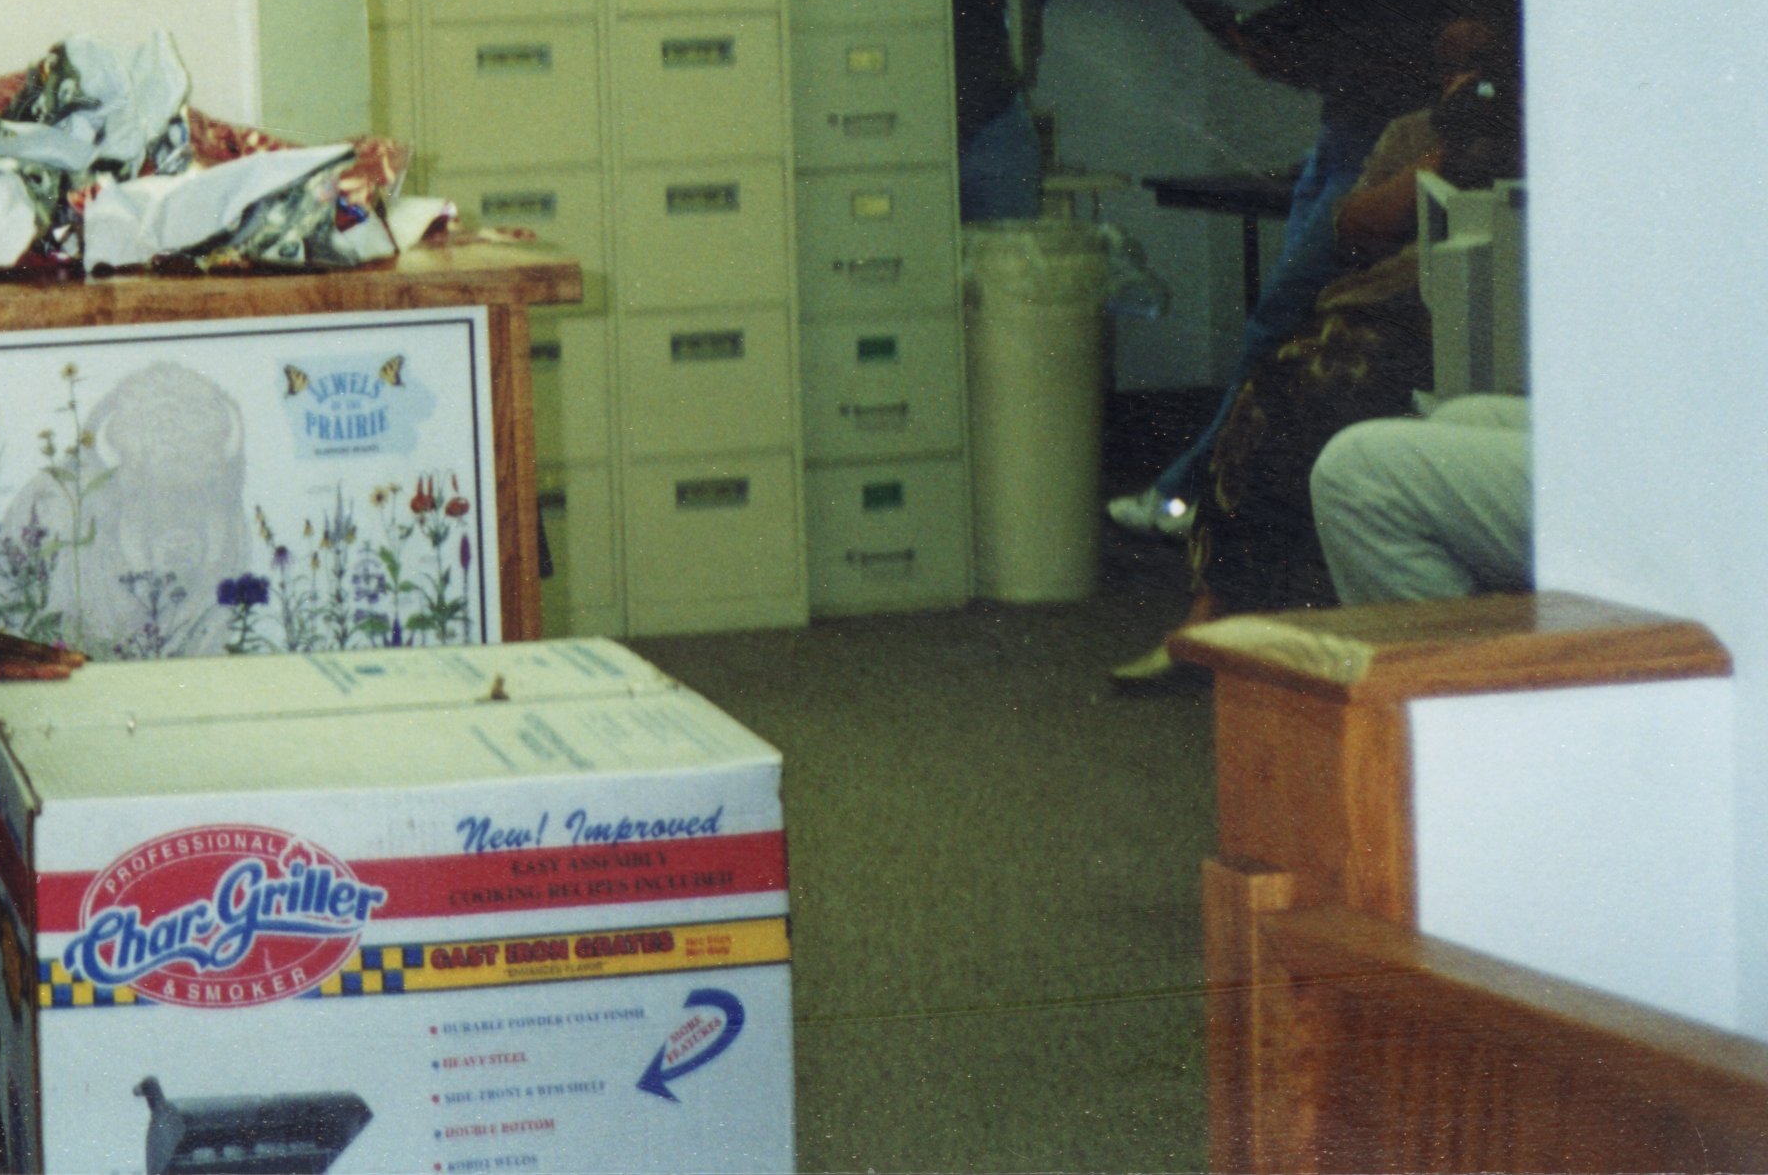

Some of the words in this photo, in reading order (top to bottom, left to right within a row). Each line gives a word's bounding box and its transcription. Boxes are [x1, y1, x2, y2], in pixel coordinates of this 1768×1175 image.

[306, 371, 385, 405] JEWELS
[305, 405, 390, 440] PRAIRIE
[455, 811, 549, 856] New!
[564, 805, 725, 848] Improved
[104, 832, 278, 895] PROFESSIONAL
[511, 856, 560, 877] EASY
[569, 849, 668, 873] ASSEMBLY
[448, 883, 542, 908] COOKING
[547, 876, 630, 901] RECIPES
[634, 870, 735, 895] INCLUDED
[430, 943, 500, 970] CAST
[504, 938, 570, 966] IRON
[574, 930, 676, 960] GRATES
[163, 977, 177, 998] &
[186, 966, 308, 1003] SMOKER
[442, 1017, 504, 1035] DURABLE
[508, 1012, 563, 1029] POWDER
[566, 1010, 600, 1025] COAT
[603, 1007, 646, 1022] FINISH
[669, 1015, 704, 1044] MORE
[666, 1015, 724, 1066] FEATURES
[442, 1054, 487, 1069] HEAVY
[488, 1052, 528, 1066] STEEL
[479, 1086, 522, 1102] FRONT
[444, 1124, 498, 1139] DOUBLE
[501, 1118, 556, 1134] BOTTOM
